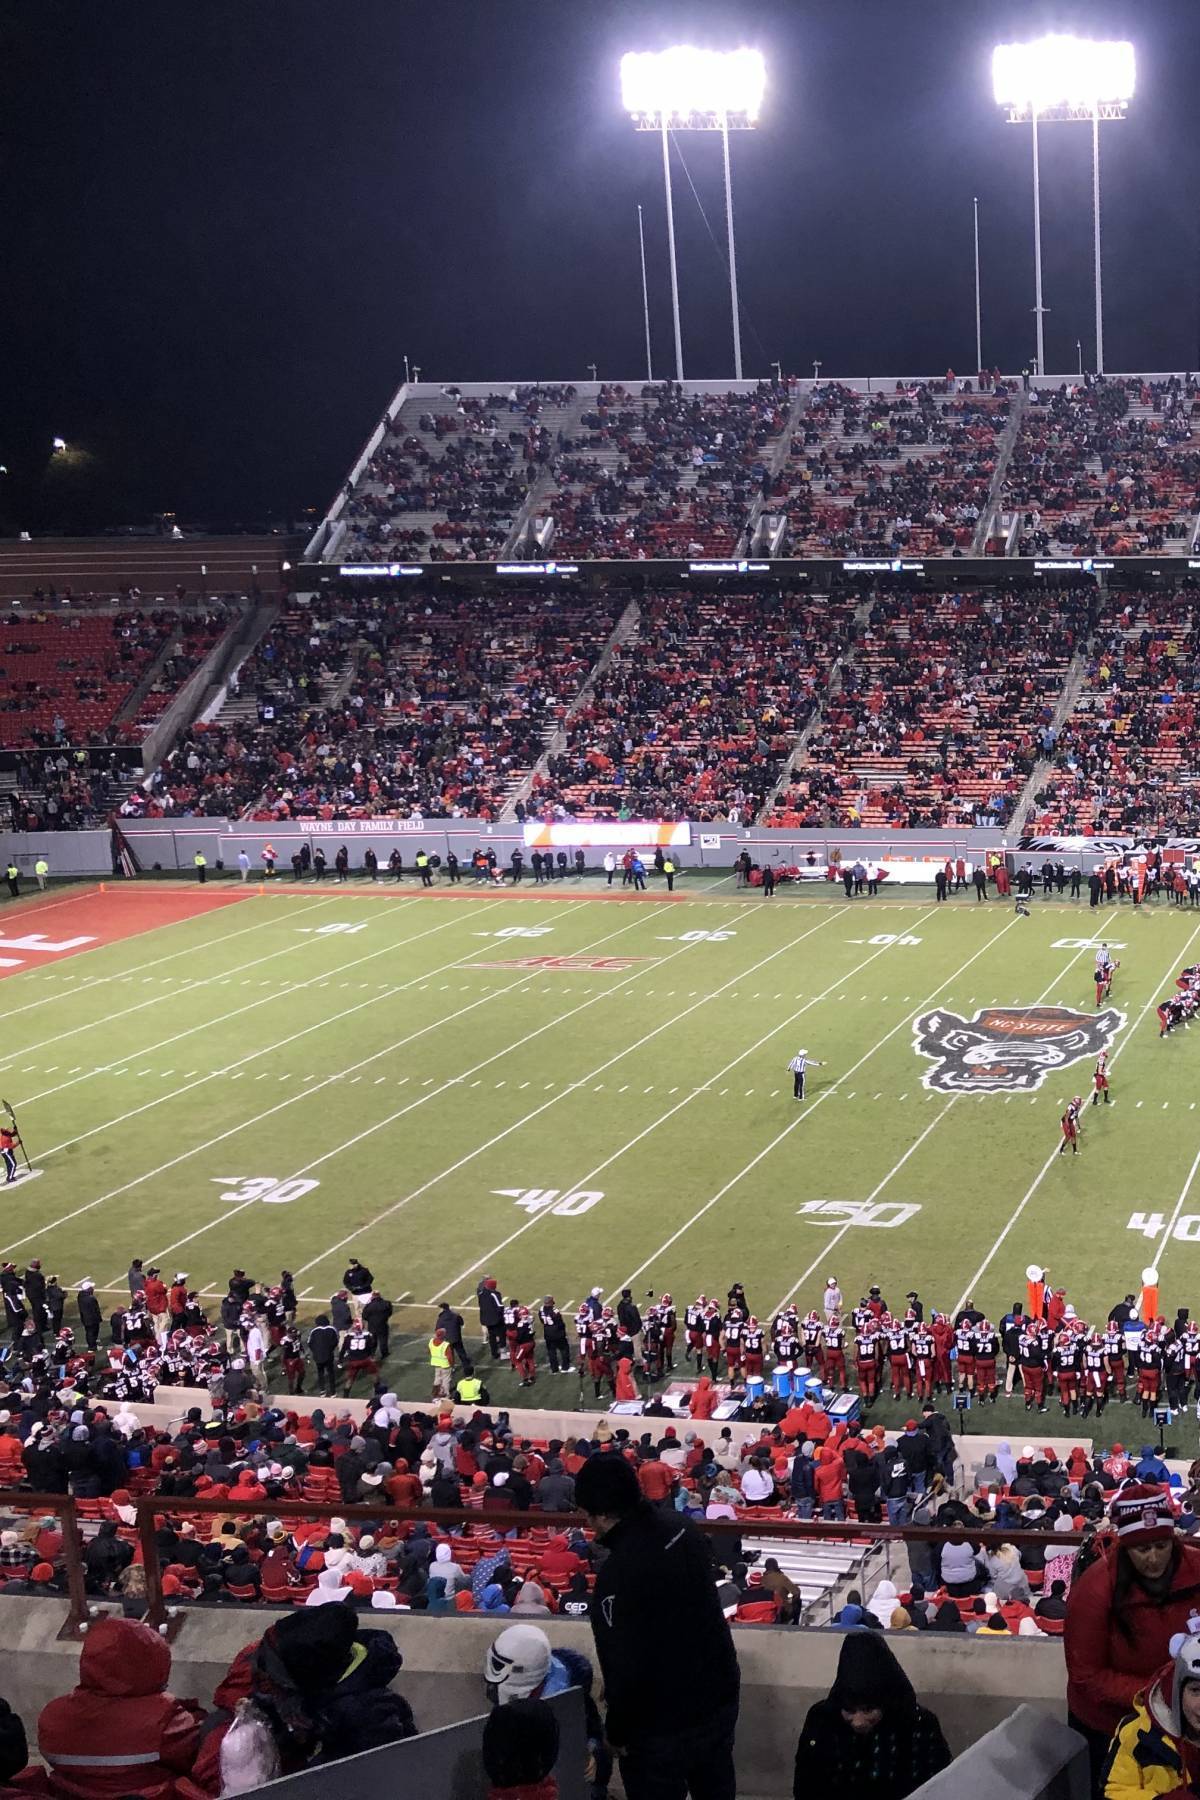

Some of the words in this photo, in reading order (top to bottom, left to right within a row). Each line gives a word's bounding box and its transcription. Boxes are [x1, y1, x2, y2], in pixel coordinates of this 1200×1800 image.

[300, 821, 333, 833] WAYNE
[337, 821, 356, 833] DAY
[360, 820, 394, 832] FAMILY
[398, 820, 424, 831] FIELD
[867, 934, 924, 945] 40
[462, 956, 658, 971] ACC
[989, 1018, 1014, 1028] NC
[1015, 1021, 1068, 1033] STATE
[219, 1177, 321, 1203] 30
[513, 1189, 605, 1215] 40
[916, 1344, 929, 1355] 33
[977, 1343, 992, 1353] 73
[1185, 1343, 1199, 1352] 24
